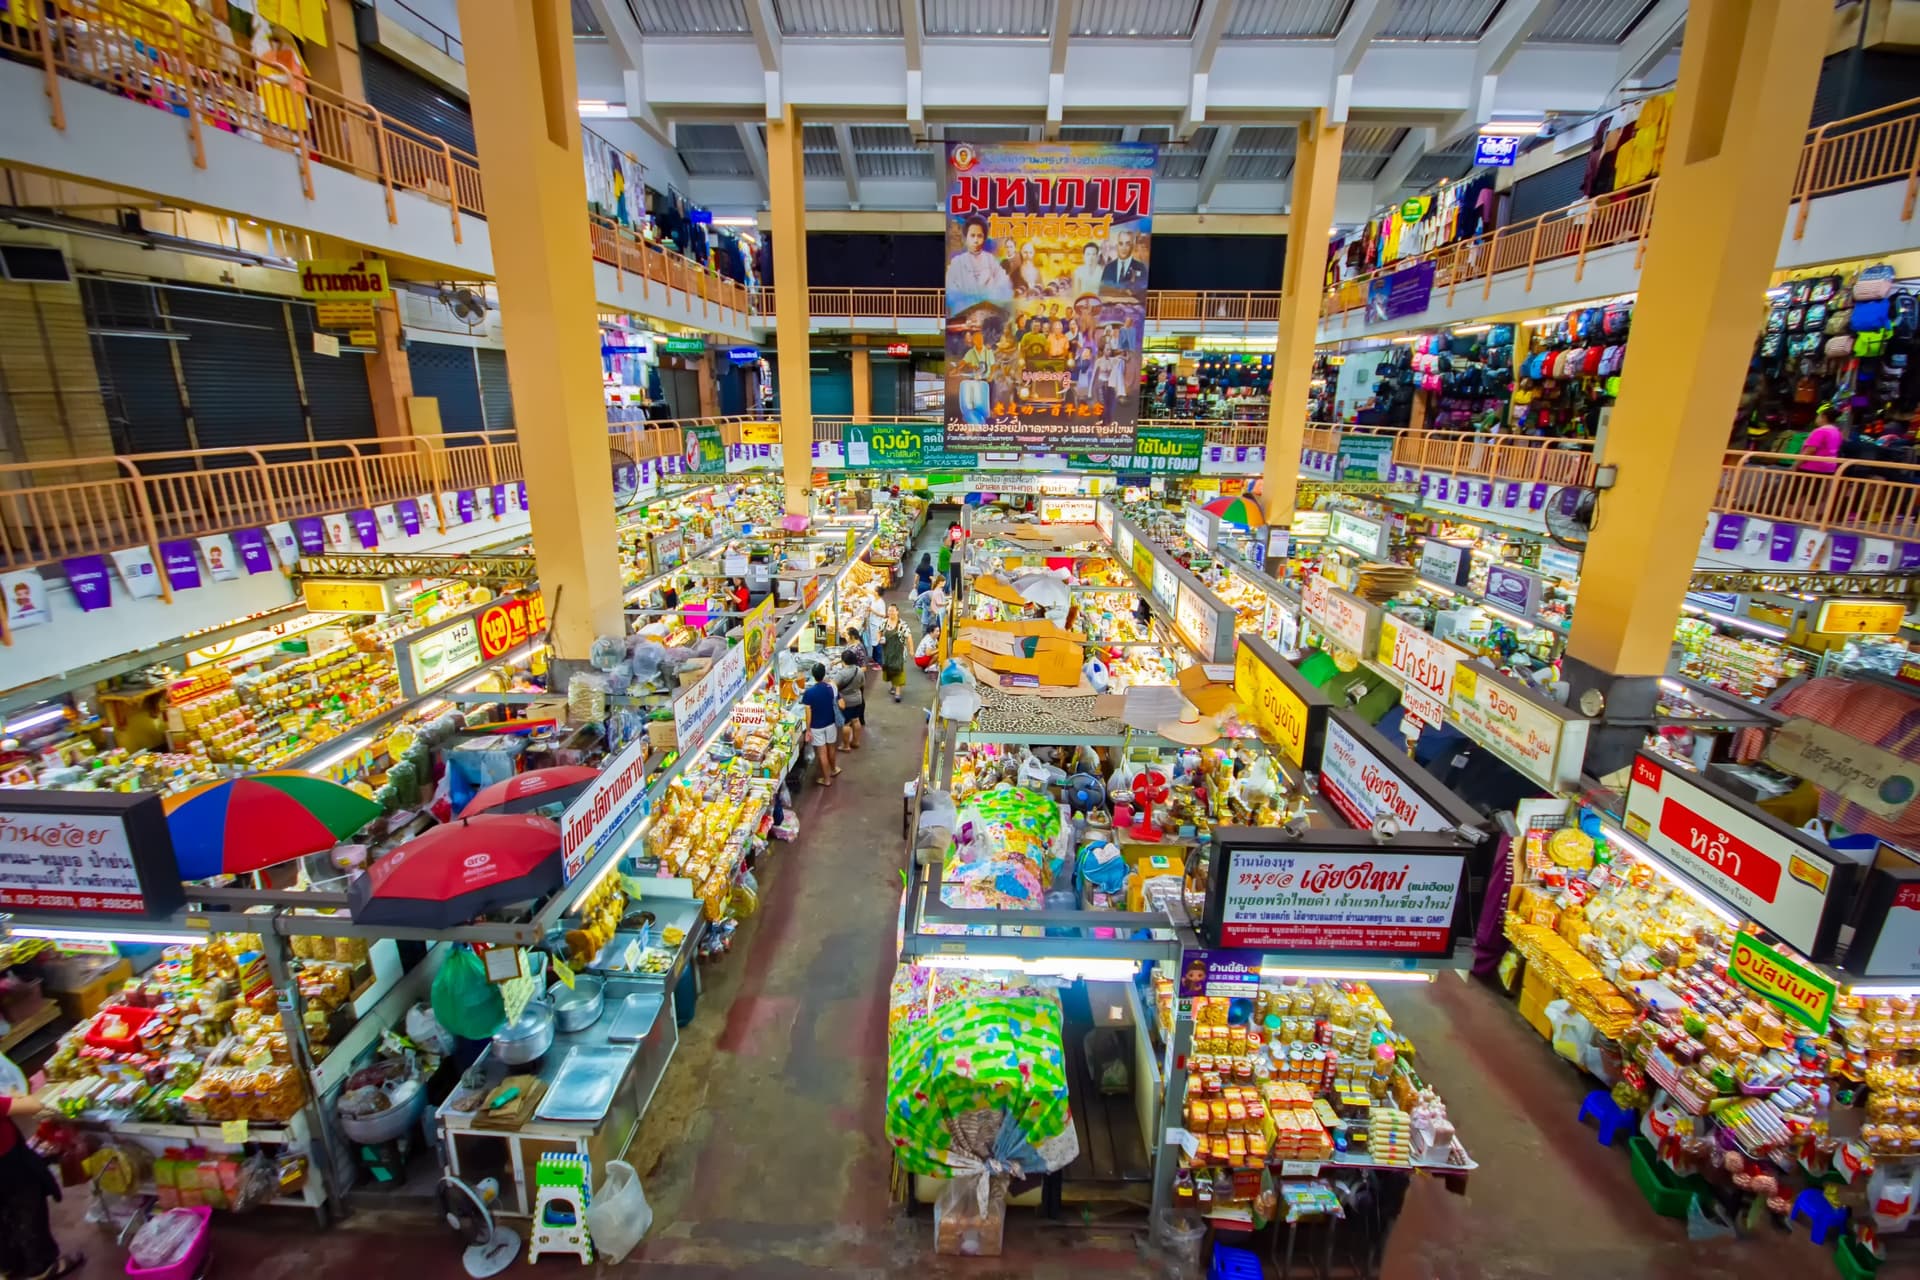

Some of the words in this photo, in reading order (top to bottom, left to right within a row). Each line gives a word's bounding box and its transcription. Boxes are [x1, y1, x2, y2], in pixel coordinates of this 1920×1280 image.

[951, 175, 1152, 217] มหากาด
[872, 430, 921, 454] ถุงผ้า
[1110, 455, 1132, 468] SAY
[1133, 456, 1150, 469] NO
[1151, 457, 1166, 470] TO
[1167, 457, 1200, 471] FOAM
[1392, 633, 1446, 697] ป้าย่น
[1637, 764, 1656, 783] ร้าน
[466, 855, 488, 866] aro
[1690, 827, 1742, 877] หล้า
[1234, 855, 1295, 875] ร้านน้องนุช
[1238, 872, 1295, 890] หมูยอ
[1228, 892, 1332, 912] หมูยอพริกไทยดำ
[1335, 894, 1450, 911] เจ้าแรกในเชียงใหม่
[1426, 915, 1445, 923] GMP
[1736, 947, 1825, 1009] วนัสนันท์
